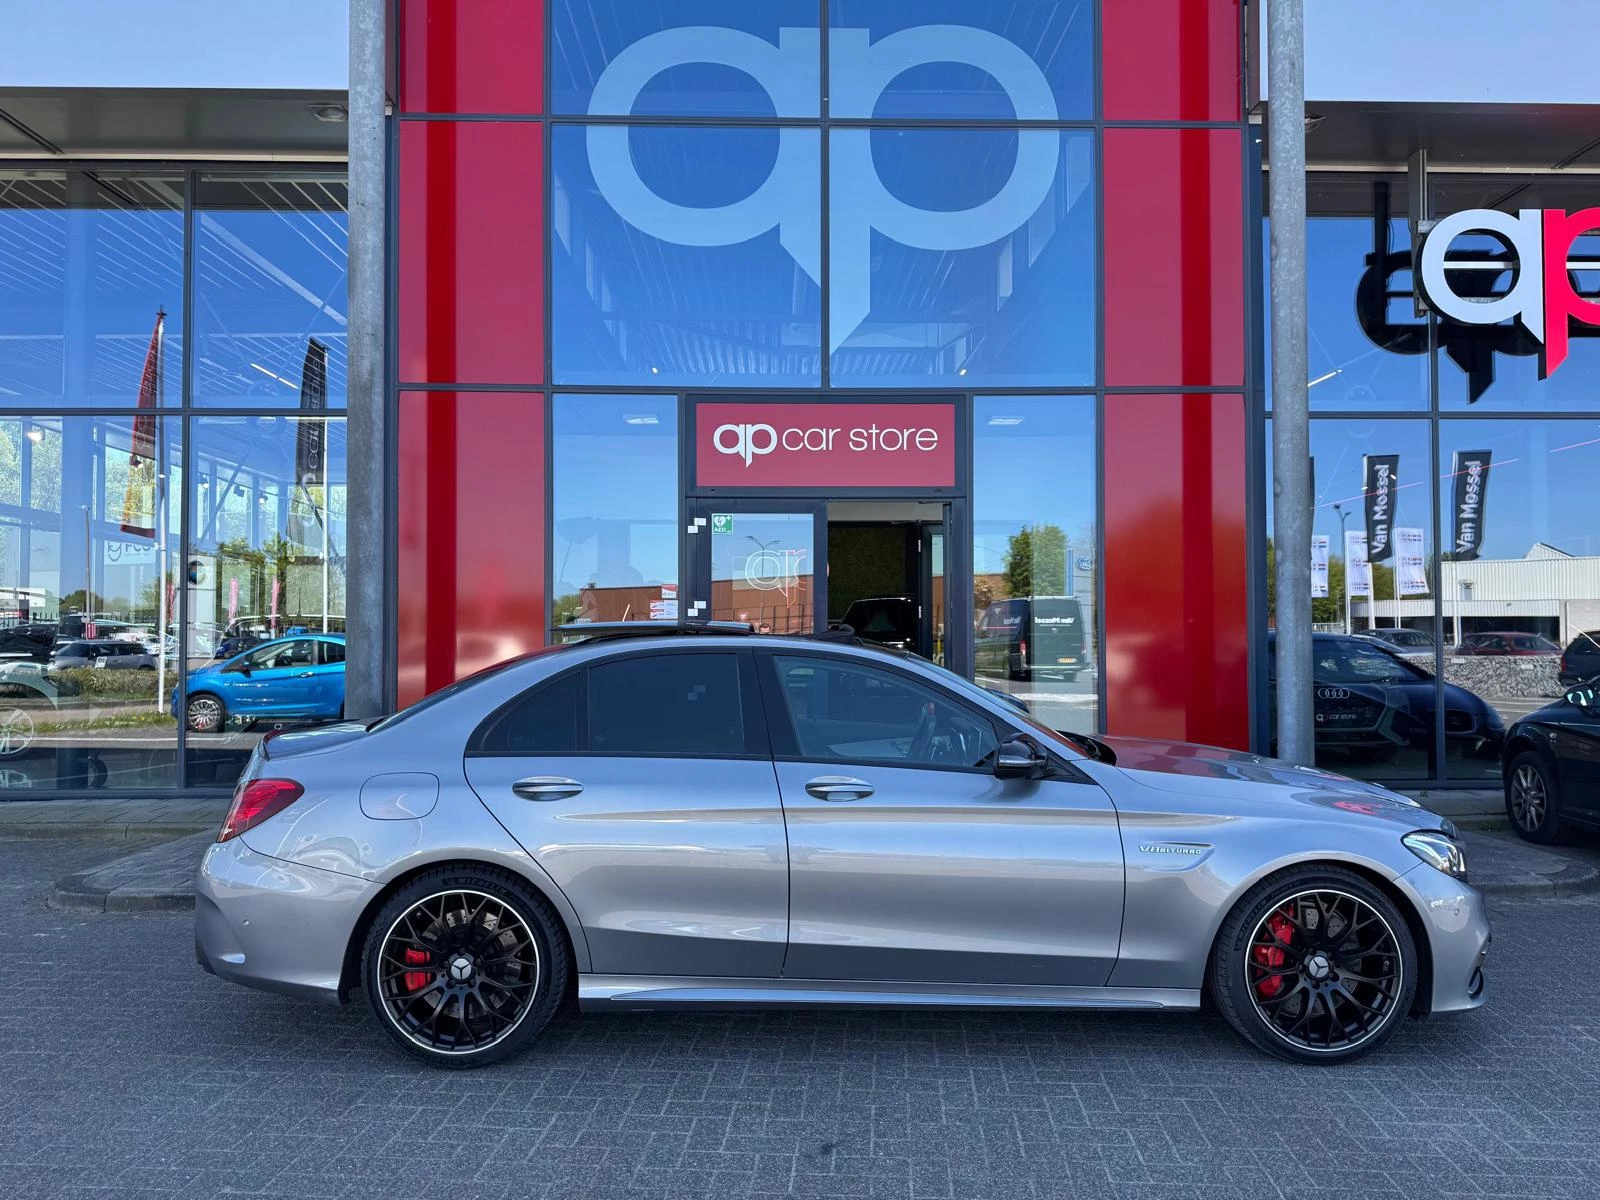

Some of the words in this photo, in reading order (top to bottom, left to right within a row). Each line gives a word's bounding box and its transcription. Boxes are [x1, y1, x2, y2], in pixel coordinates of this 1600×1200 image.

[586, 24, 1060, 357] ap
[713, 424, 778, 468] ap
[782, 428, 841, 451] car
[849, 424, 938, 451] store
[1372, 464, 1390, 520] Mossel
[1459, 460, 1482, 518] Mossel
[1371, 524, 1388, 553] Van
[1456, 522, 1476, 553] Van
[457, 877, 508, 895] MICHELIN
